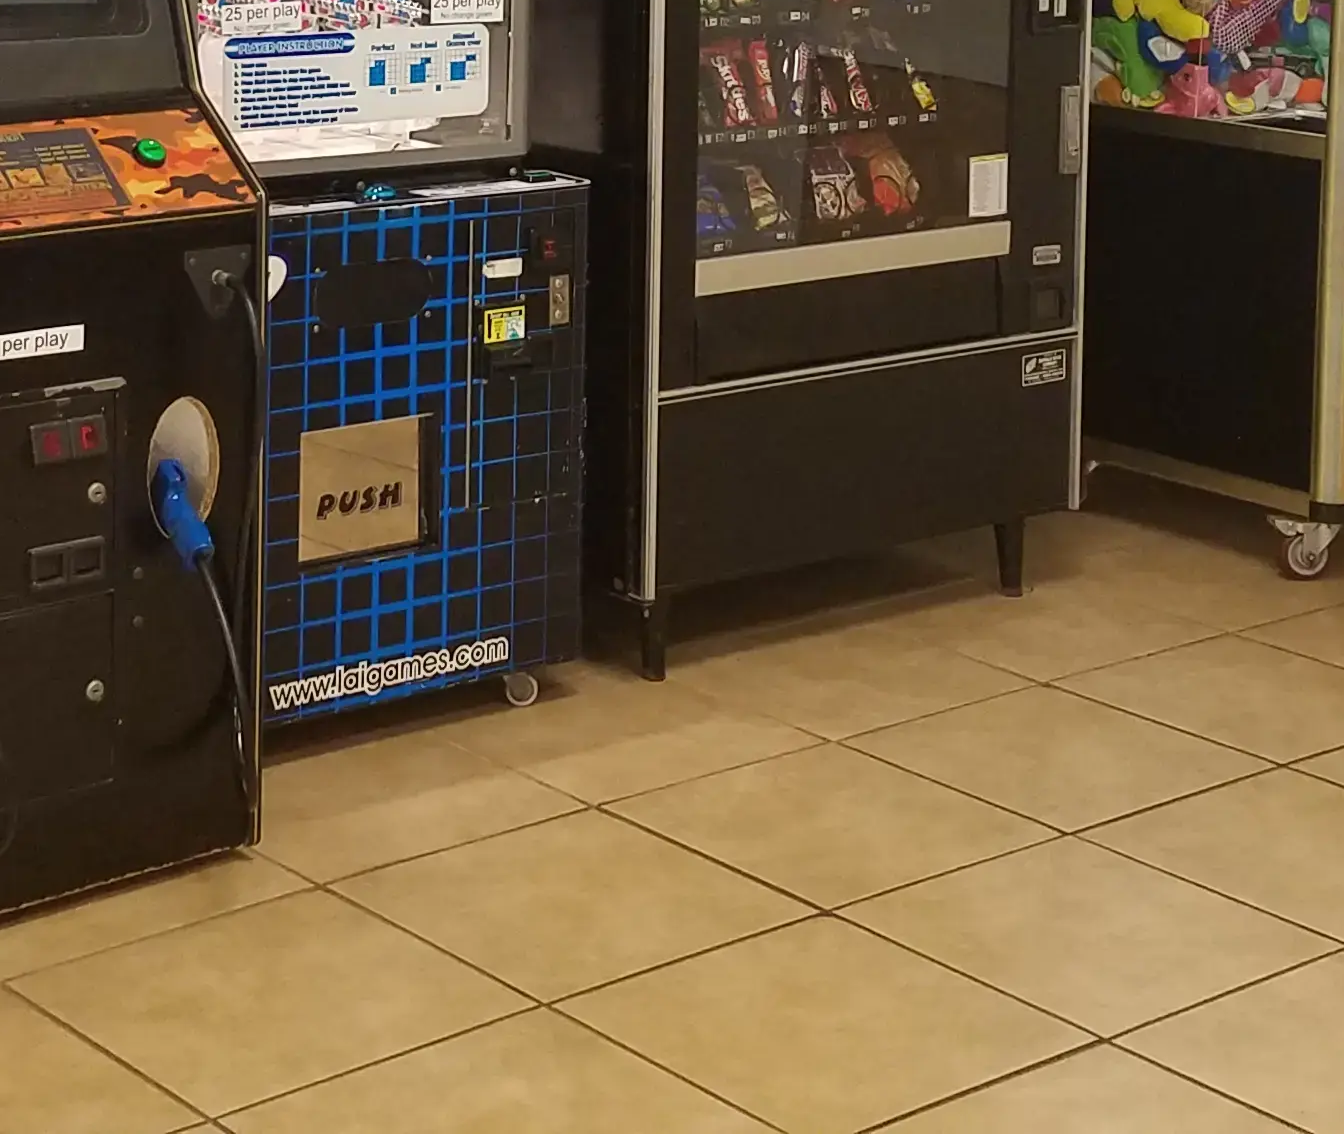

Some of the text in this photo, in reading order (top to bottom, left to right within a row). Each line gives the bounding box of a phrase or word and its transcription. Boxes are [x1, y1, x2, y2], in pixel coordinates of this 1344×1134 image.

[224, 2, 301, 22] 25 per play
[237, 37, 345, 55] PLAYER INSTRUCTION
[2, 336, 30, 357] per
[34, 331, 69, 352] play
[316, 481, 403, 521] PUSH
[269, 636, 510, 711] www.laigames.com
